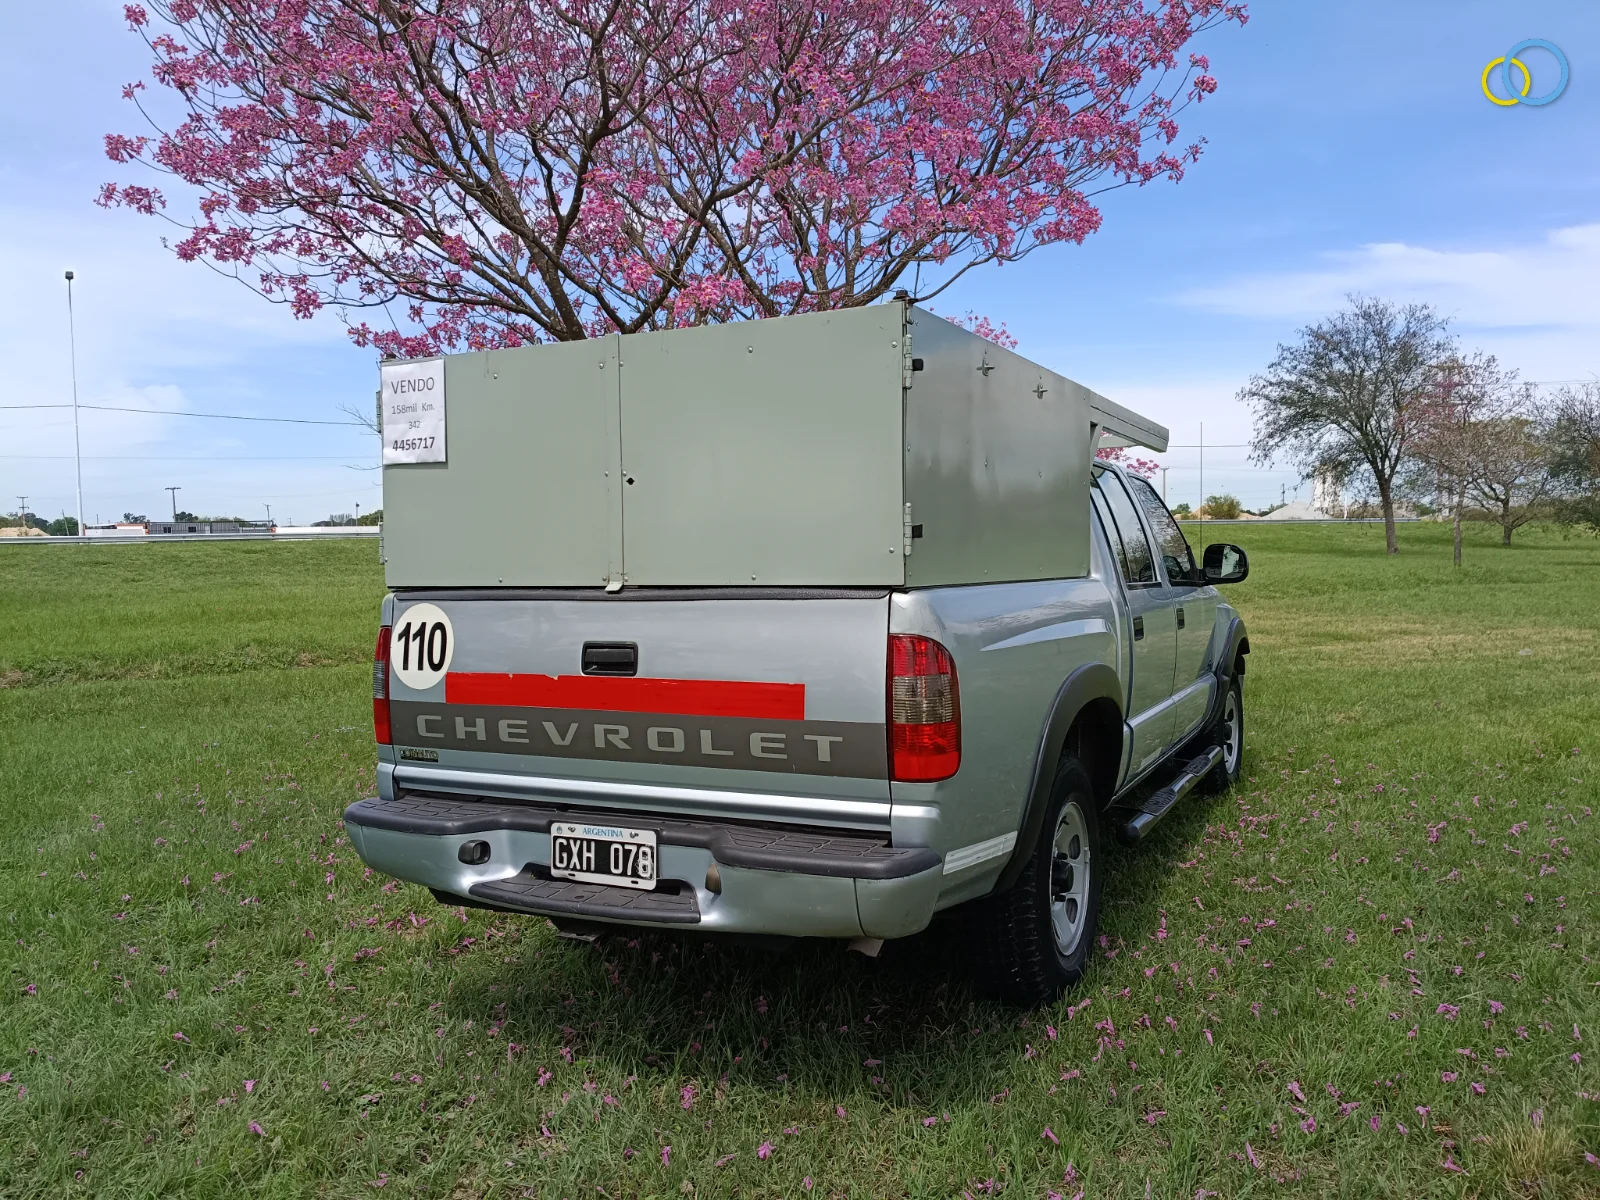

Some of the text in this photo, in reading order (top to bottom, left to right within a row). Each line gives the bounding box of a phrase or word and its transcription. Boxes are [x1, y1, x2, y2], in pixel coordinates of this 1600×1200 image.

[391, 377, 435, 394] VENDO
[391, 402, 435, 415] 158mil Km.
[408, 420, 421, 430] 342
[392, 437, 435, 452] 4456717
[398, 621, 447, 672] 110
[416, 714, 843, 762] CHEVROLET
[582, 827, 623, 838] ARGENTINA
[555, 838, 652, 878] GXH 078
